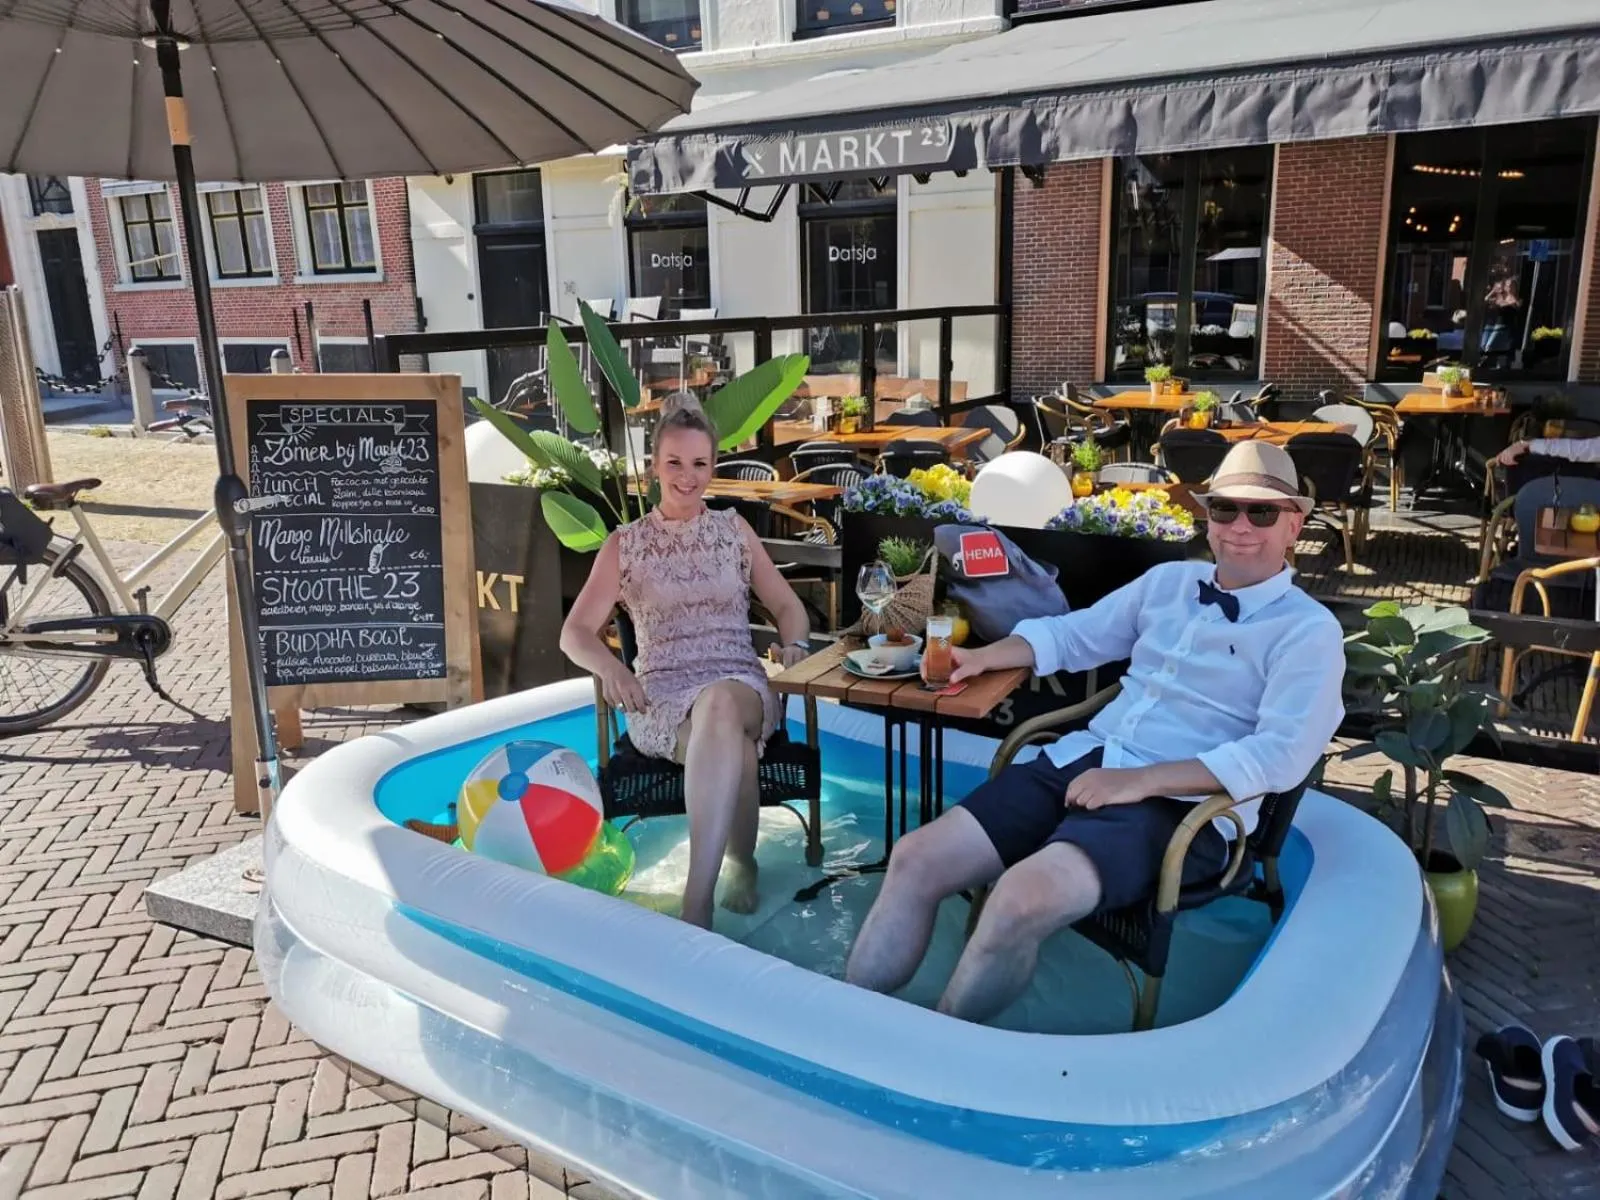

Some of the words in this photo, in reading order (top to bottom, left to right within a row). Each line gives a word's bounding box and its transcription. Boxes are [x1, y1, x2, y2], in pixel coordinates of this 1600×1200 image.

[779, 129, 912, 174] MARKT
[920, 126, 946, 147] 23
[651, 252, 693, 270] Datsja
[829, 245, 877, 264] Datsja
[289, 407, 396, 424] SPECIALS
[320, 517, 410, 561] Milkshake
[965, 547, 1003, 560] HEMA
[262, 575, 377, 605] SMOOTHIE
[383, 572, 420, 599] 23
[476, 569, 524, 613] KT
[276, 629, 355, 657] BUDDHA
[359, 626, 413, 648] BOWL
